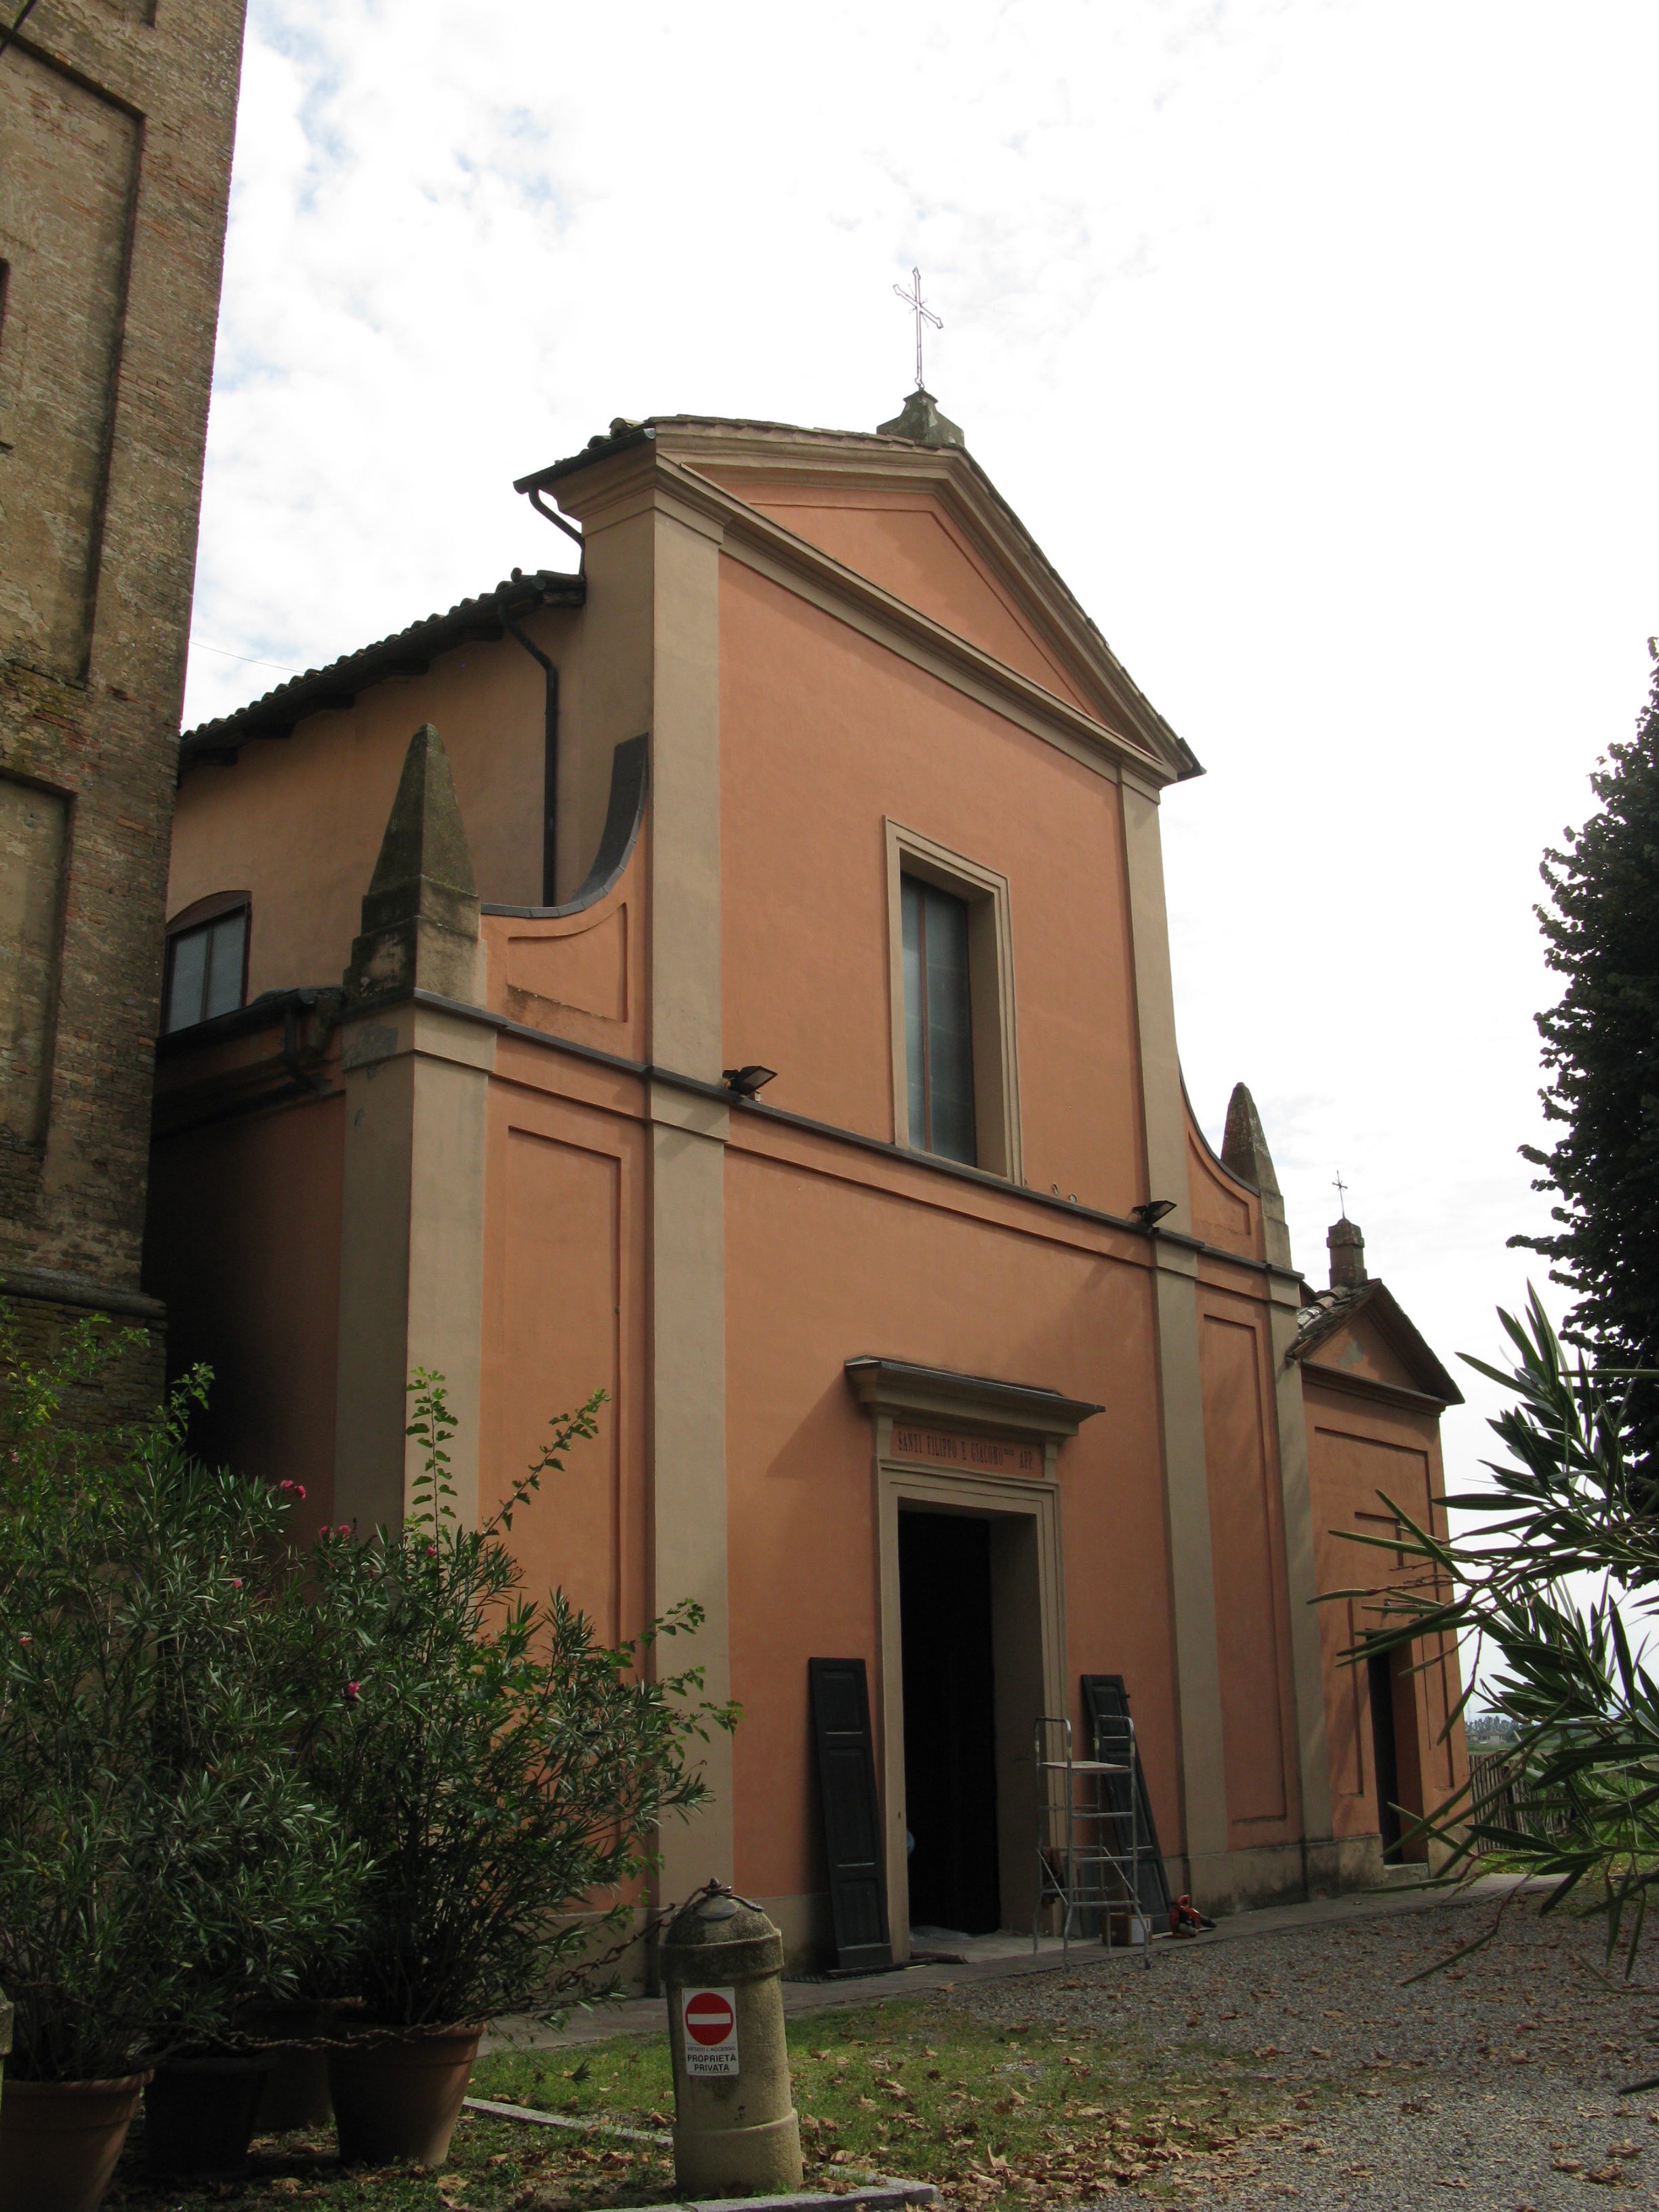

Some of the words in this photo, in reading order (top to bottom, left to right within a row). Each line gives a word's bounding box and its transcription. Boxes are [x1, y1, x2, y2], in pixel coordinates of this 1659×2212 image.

[898, 1431, 922, 1454] SANTI
[926, 1435, 957, 1458] FILIPPO
[961, 1442, 966, 1460] E
[970, 1442, 1003, 1465] GIACOMO
[687, 2053, 737, 2062] PROPRIETÀ
[694, 2064, 730, 2072] PRIVATA
